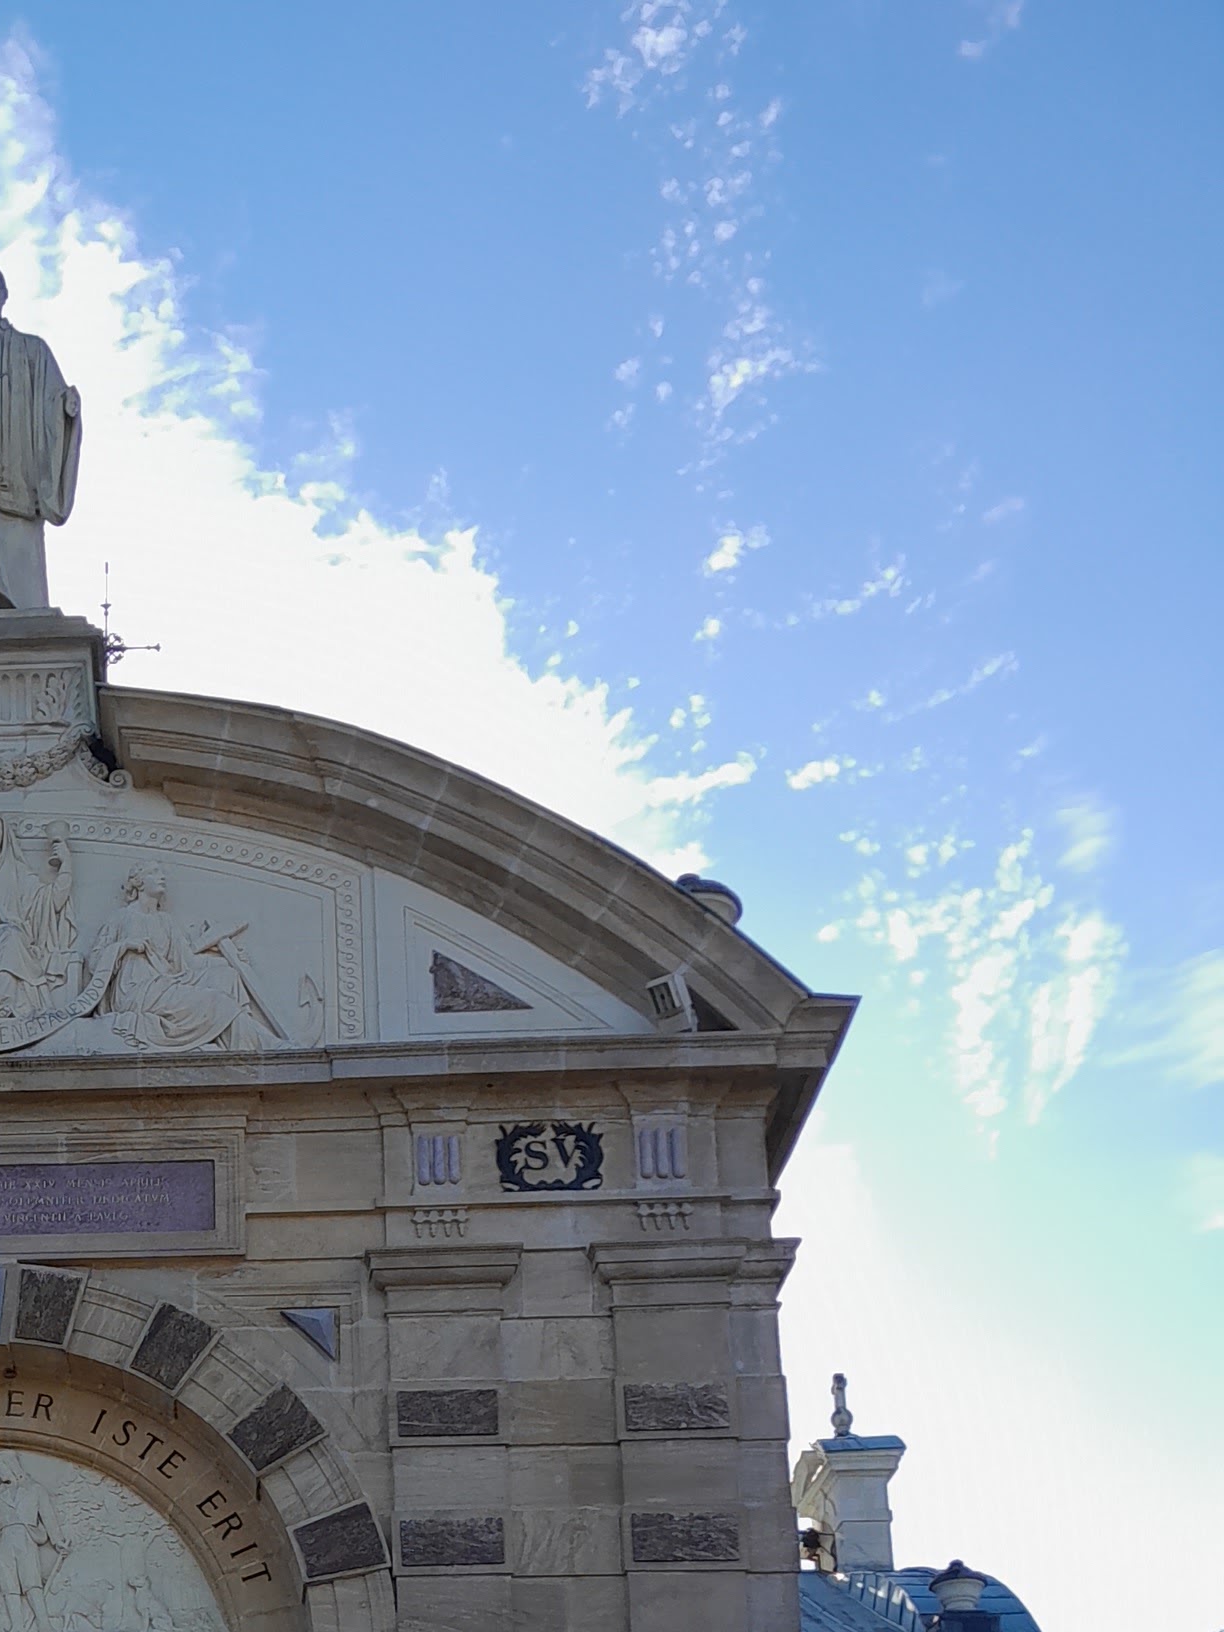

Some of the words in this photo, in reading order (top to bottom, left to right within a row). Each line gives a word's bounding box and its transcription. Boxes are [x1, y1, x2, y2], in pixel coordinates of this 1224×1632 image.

[524, 1137, 577, 1170] SV
[90, 1408, 187, 1480] ISTE
[196, 1489, 272, 1585] ERIT
